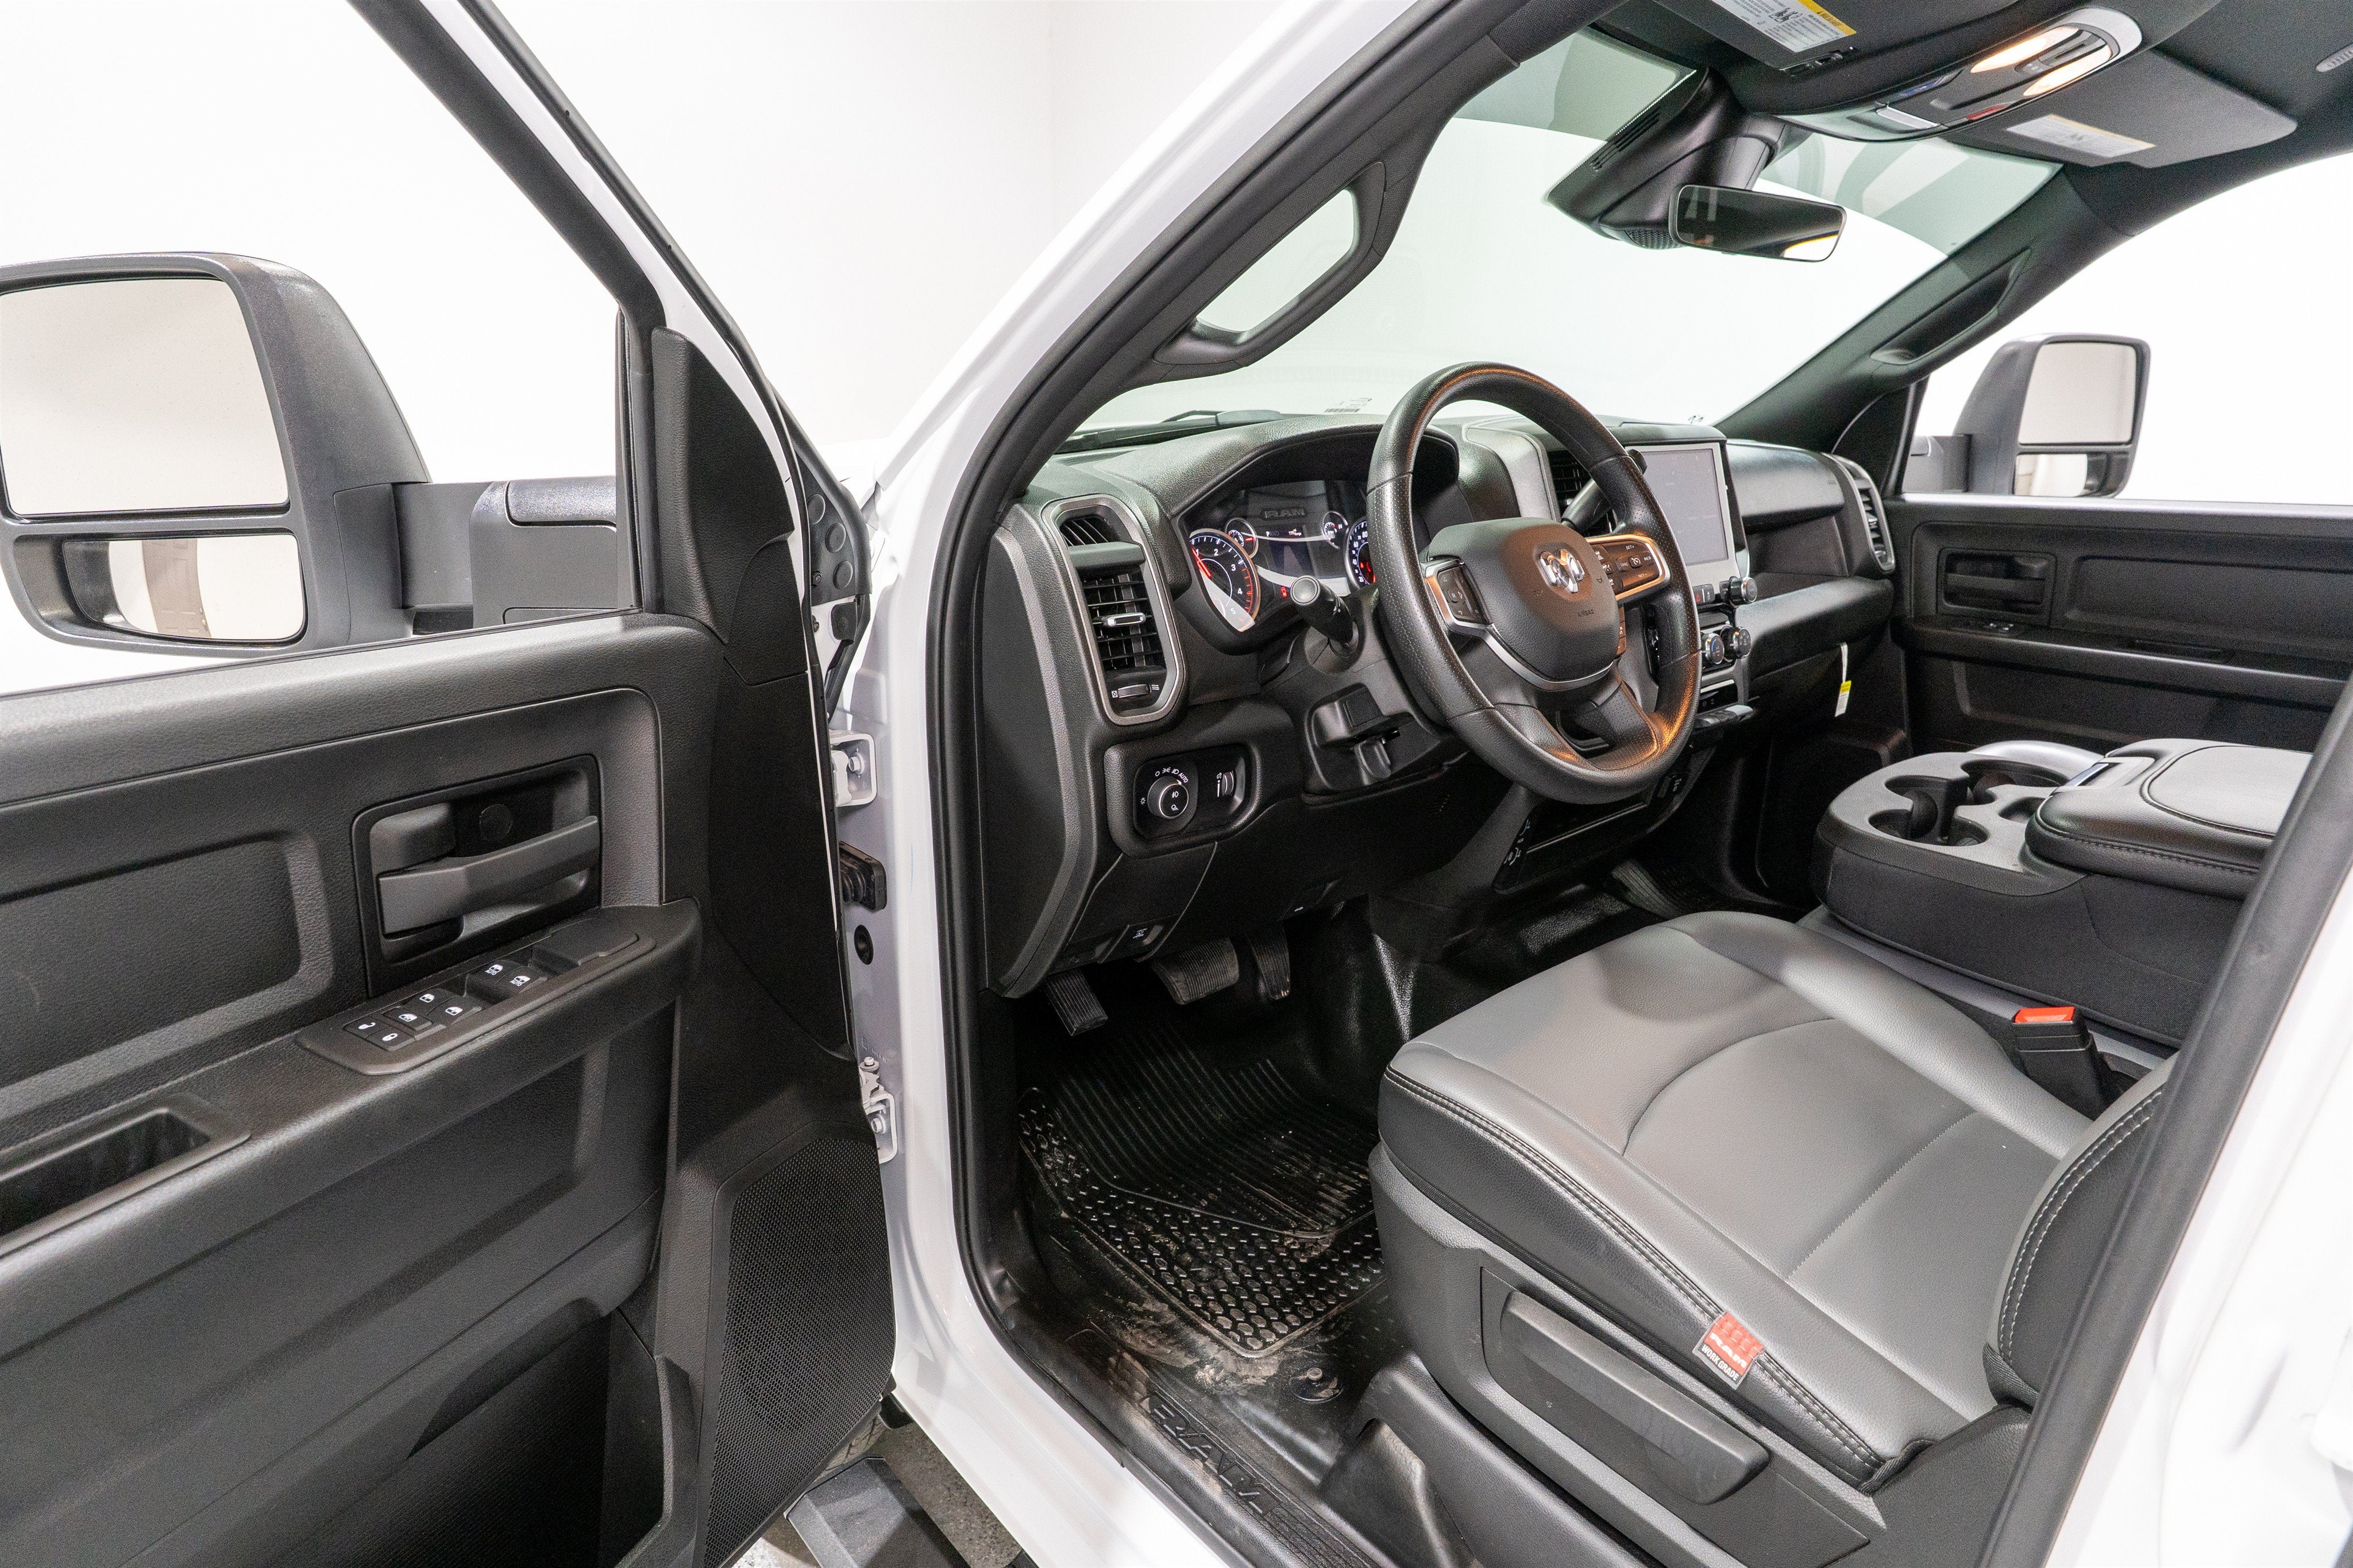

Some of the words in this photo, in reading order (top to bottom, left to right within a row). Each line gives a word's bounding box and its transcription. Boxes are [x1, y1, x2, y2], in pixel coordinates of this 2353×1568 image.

[1178, 773, 1189, 783] AUTO
[1702, 1344, 1721, 1365] WORK
[1718, 1360, 1739, 1381] GRADE
[1710, 1332, 1747, 1369] RAM
